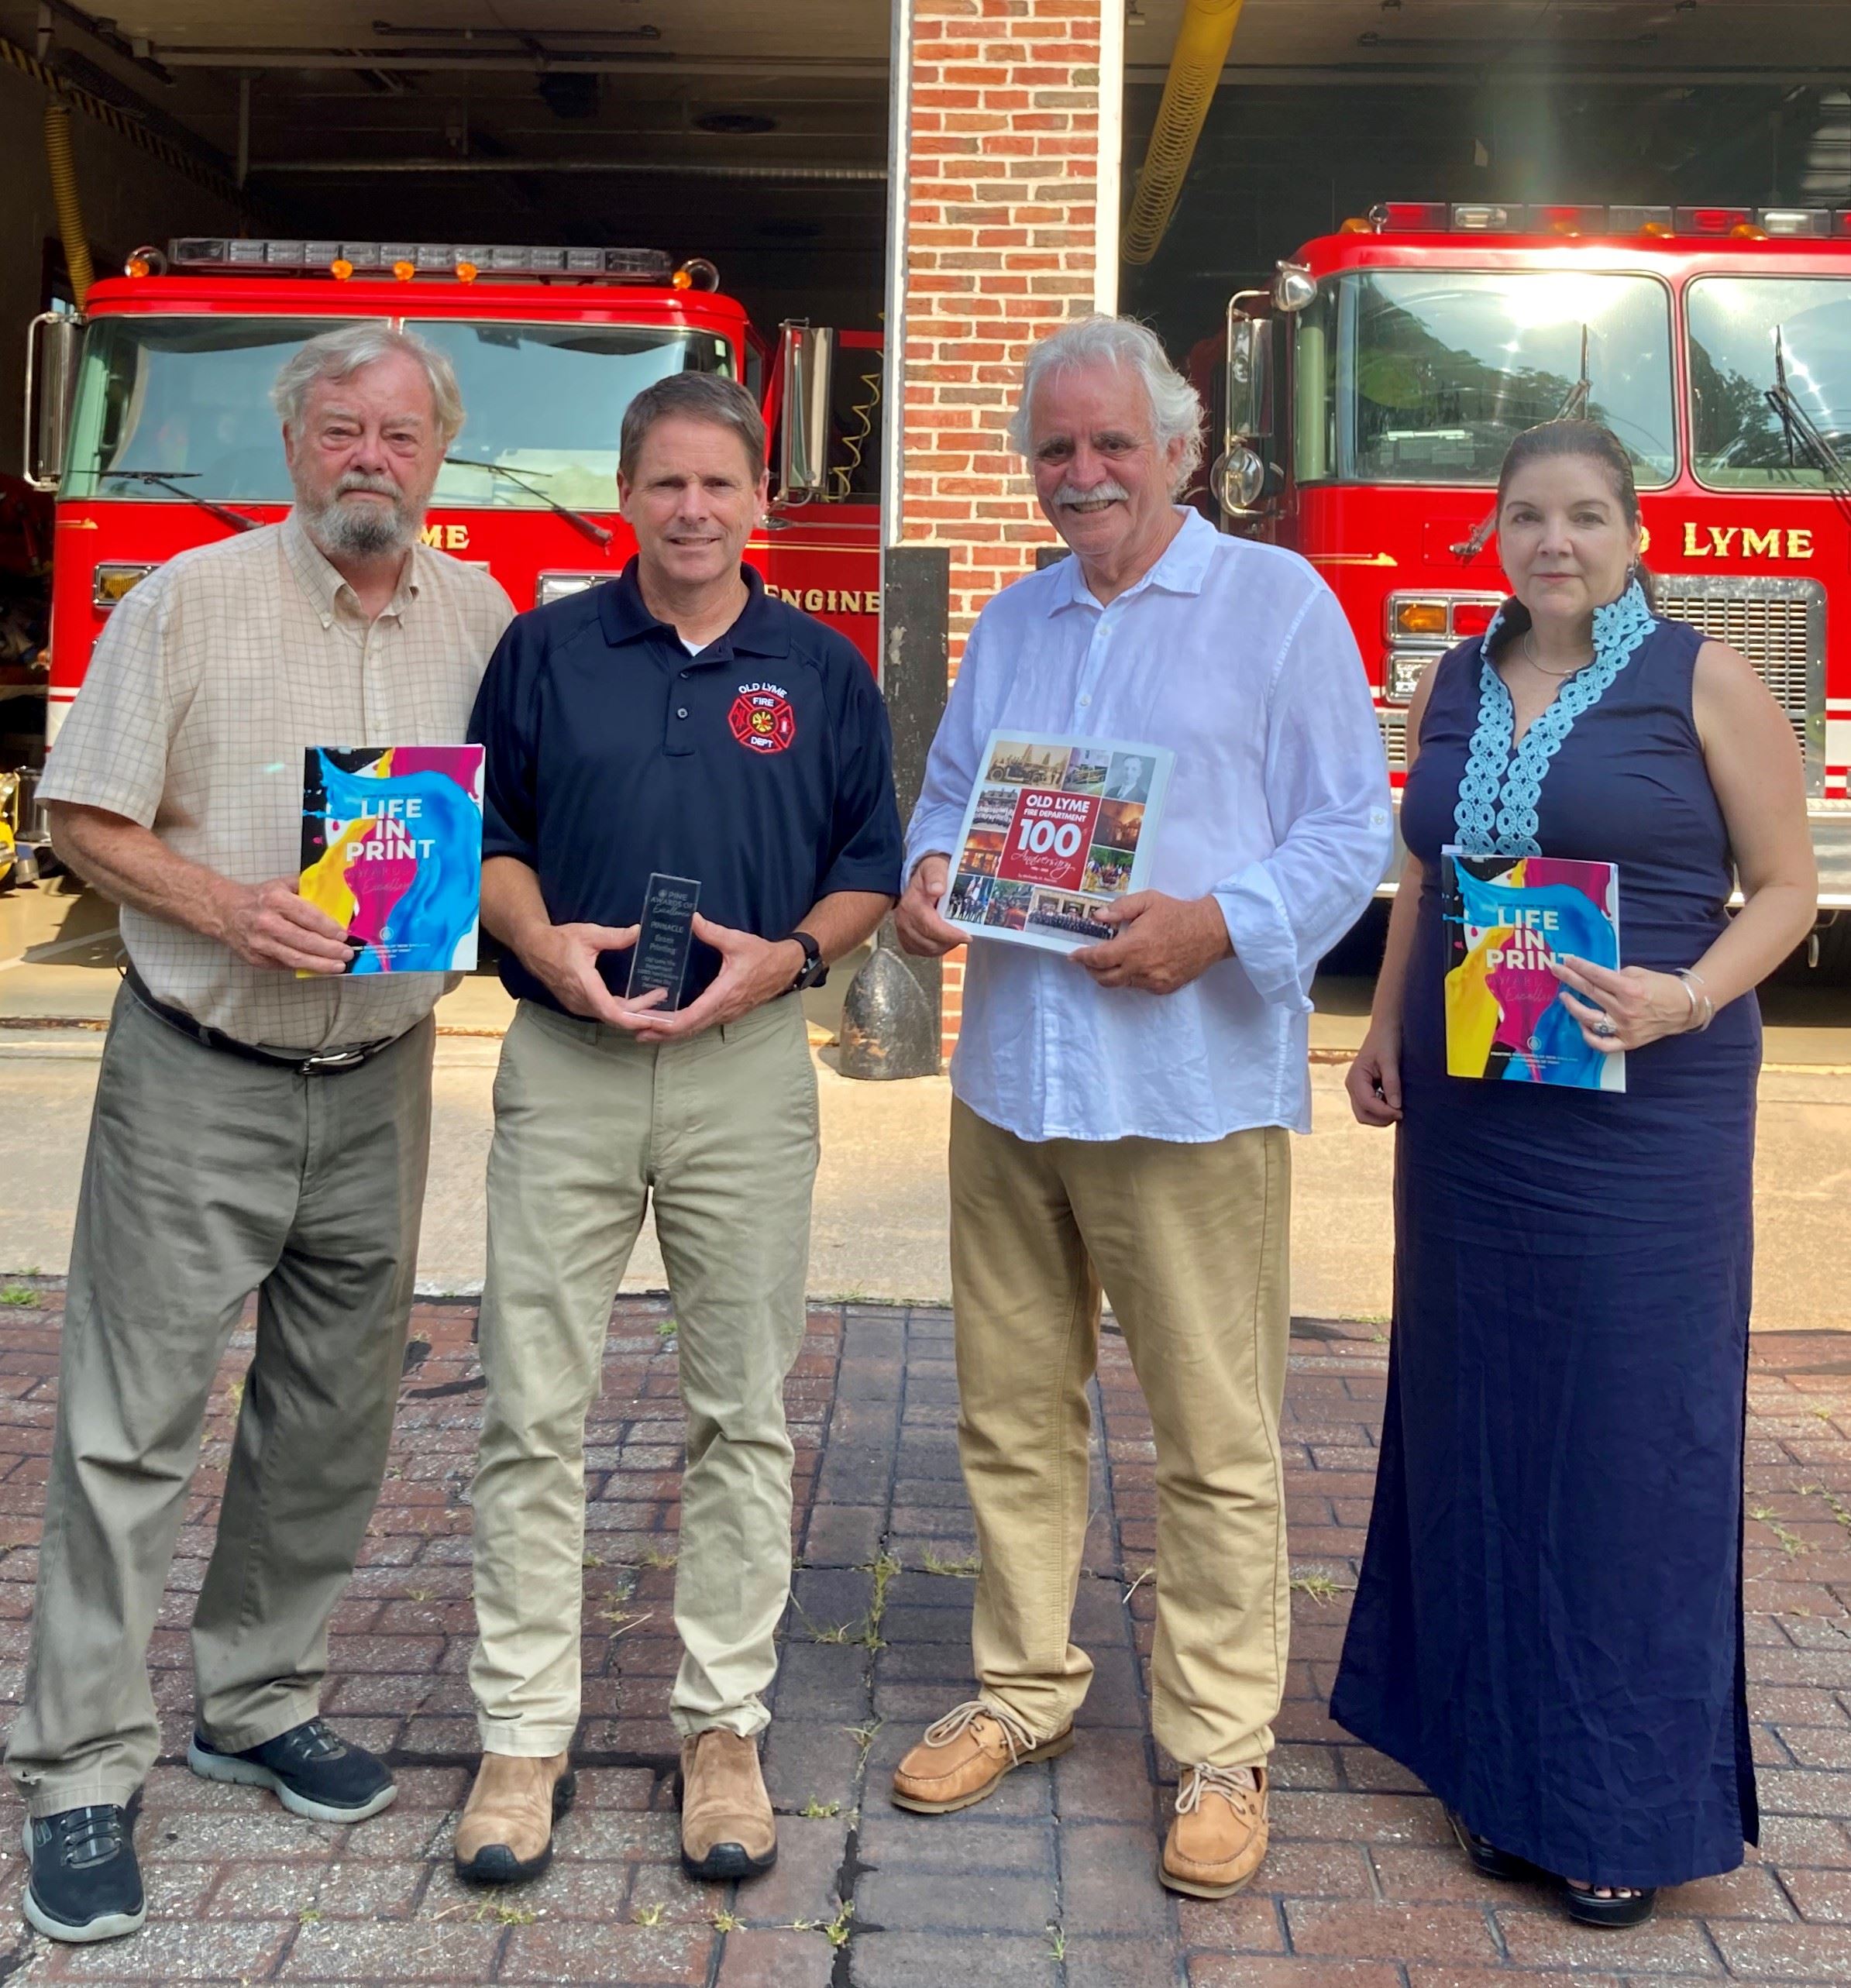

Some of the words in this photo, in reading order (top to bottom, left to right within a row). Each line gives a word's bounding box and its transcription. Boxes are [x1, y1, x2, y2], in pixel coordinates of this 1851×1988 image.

[418, 524, 470, 549] ME
[1684, 522, 1815, 558] LYME
[738, 683, 759, 693] OLD
[762, 683, 787, 698] LYME
[752, 697, 774, 707] FIRE
[751, 736, 773, 748] DEPT
[361, 798, 422, 820] LIFE
[1026, 794, 1053, 808] OLD
[1055, 797, 1090, 813] LYME
[1039, 809, 1086, 822] DEPARTMENT
[375, 819, 405, 840] IN
[1017, 818, 1082, 858] 100
[346, 839, 435, 862] PRINT
[668, 891, 688, 901] PINE
[650, 921, 683, 934] PINNACLE
[1498, 907, 1559, 930] LIFE
[1515, 929, 1544, 951] IN
